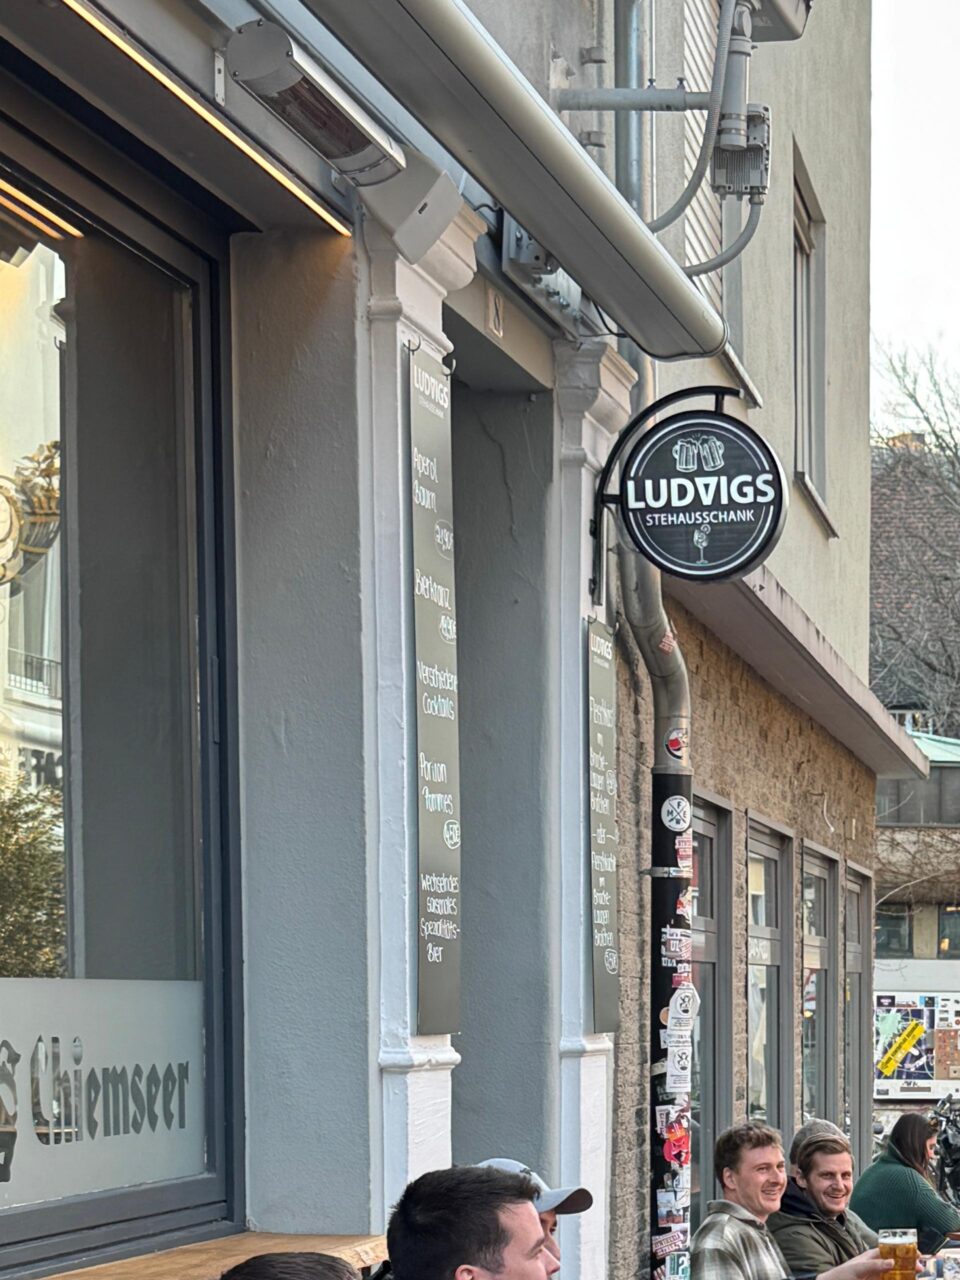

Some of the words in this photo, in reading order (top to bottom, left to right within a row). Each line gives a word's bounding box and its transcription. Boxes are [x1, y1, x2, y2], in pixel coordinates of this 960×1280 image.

[413, 365, 449, 409] LUDVIGS
[627, 473, 775, 509] LUDVIGS
[646, 510, 755, 526] STEHAUSSCHANK
[30, 1034, 189, 1146] Chiemseer
